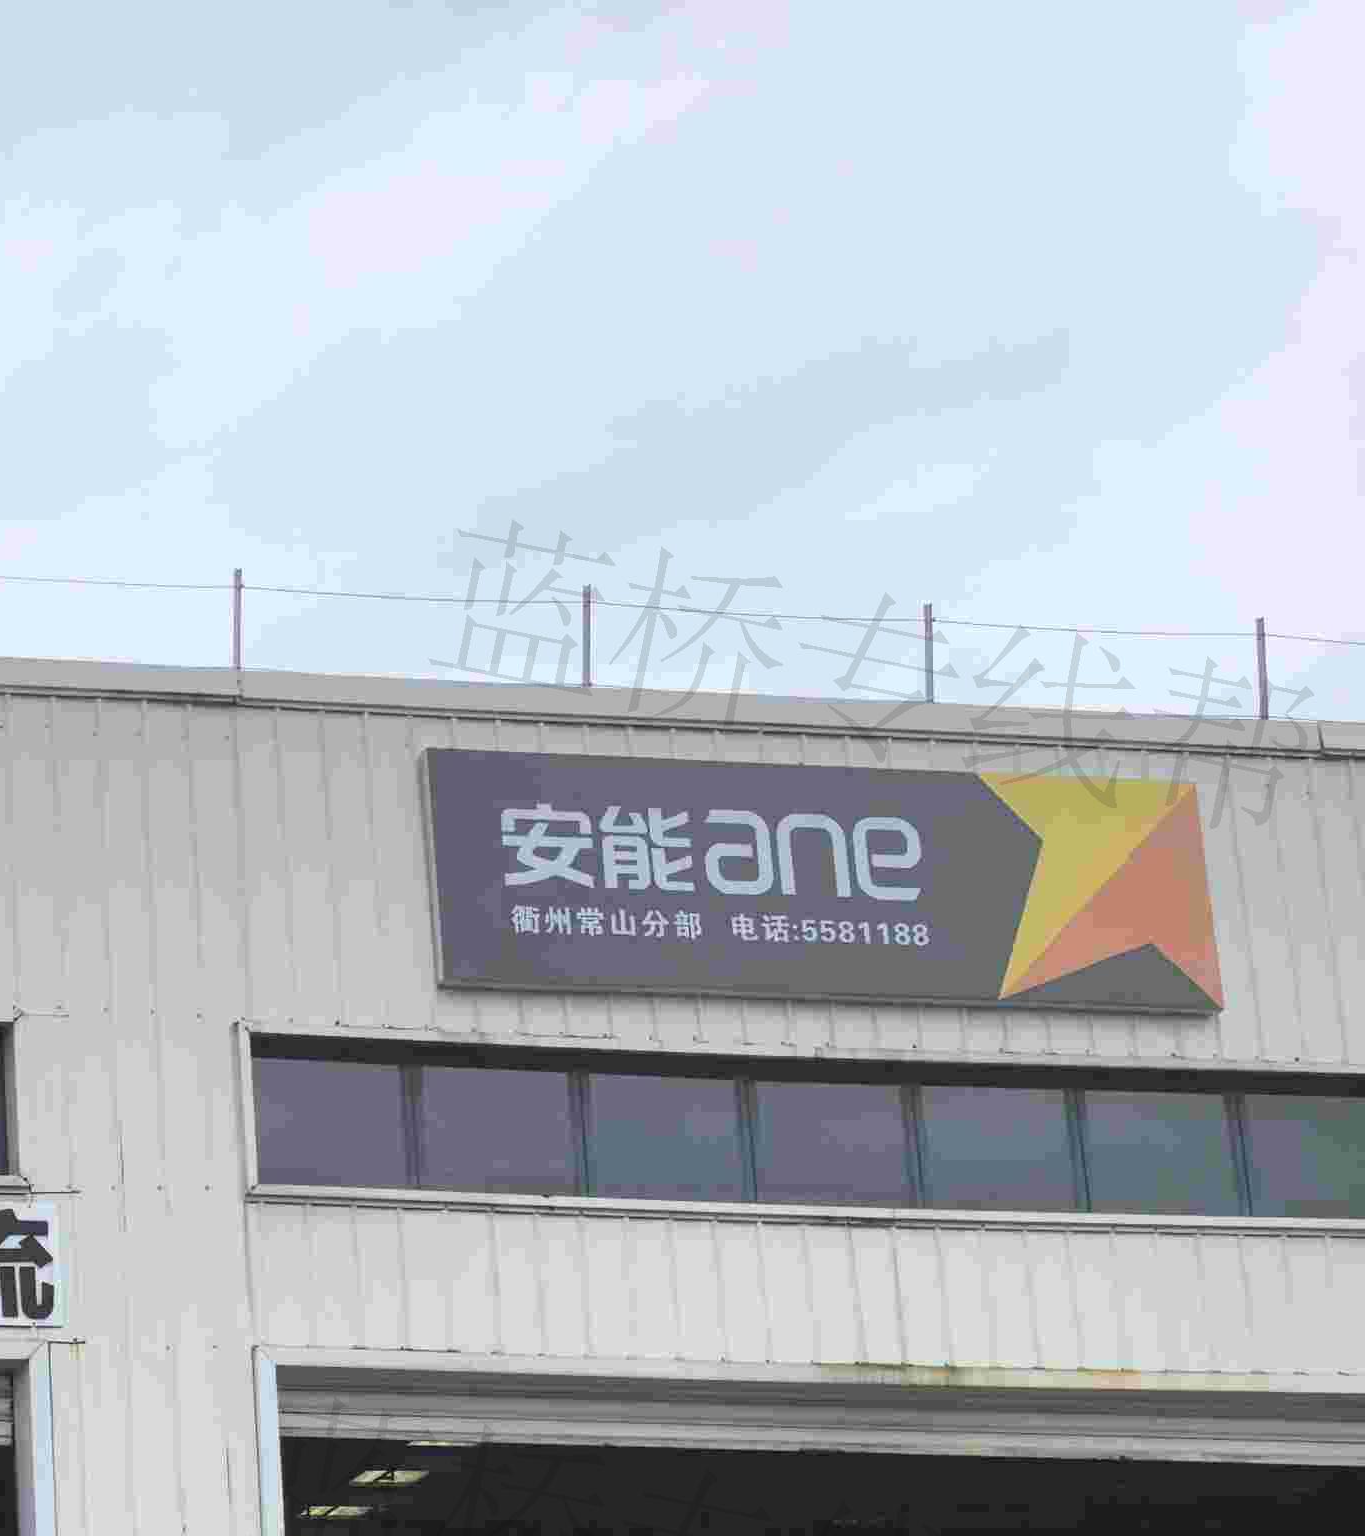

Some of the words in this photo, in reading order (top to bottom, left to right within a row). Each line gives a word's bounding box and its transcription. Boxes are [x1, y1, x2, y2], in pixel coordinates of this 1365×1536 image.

[510, 904, 702, 939] 衢州常山分部
